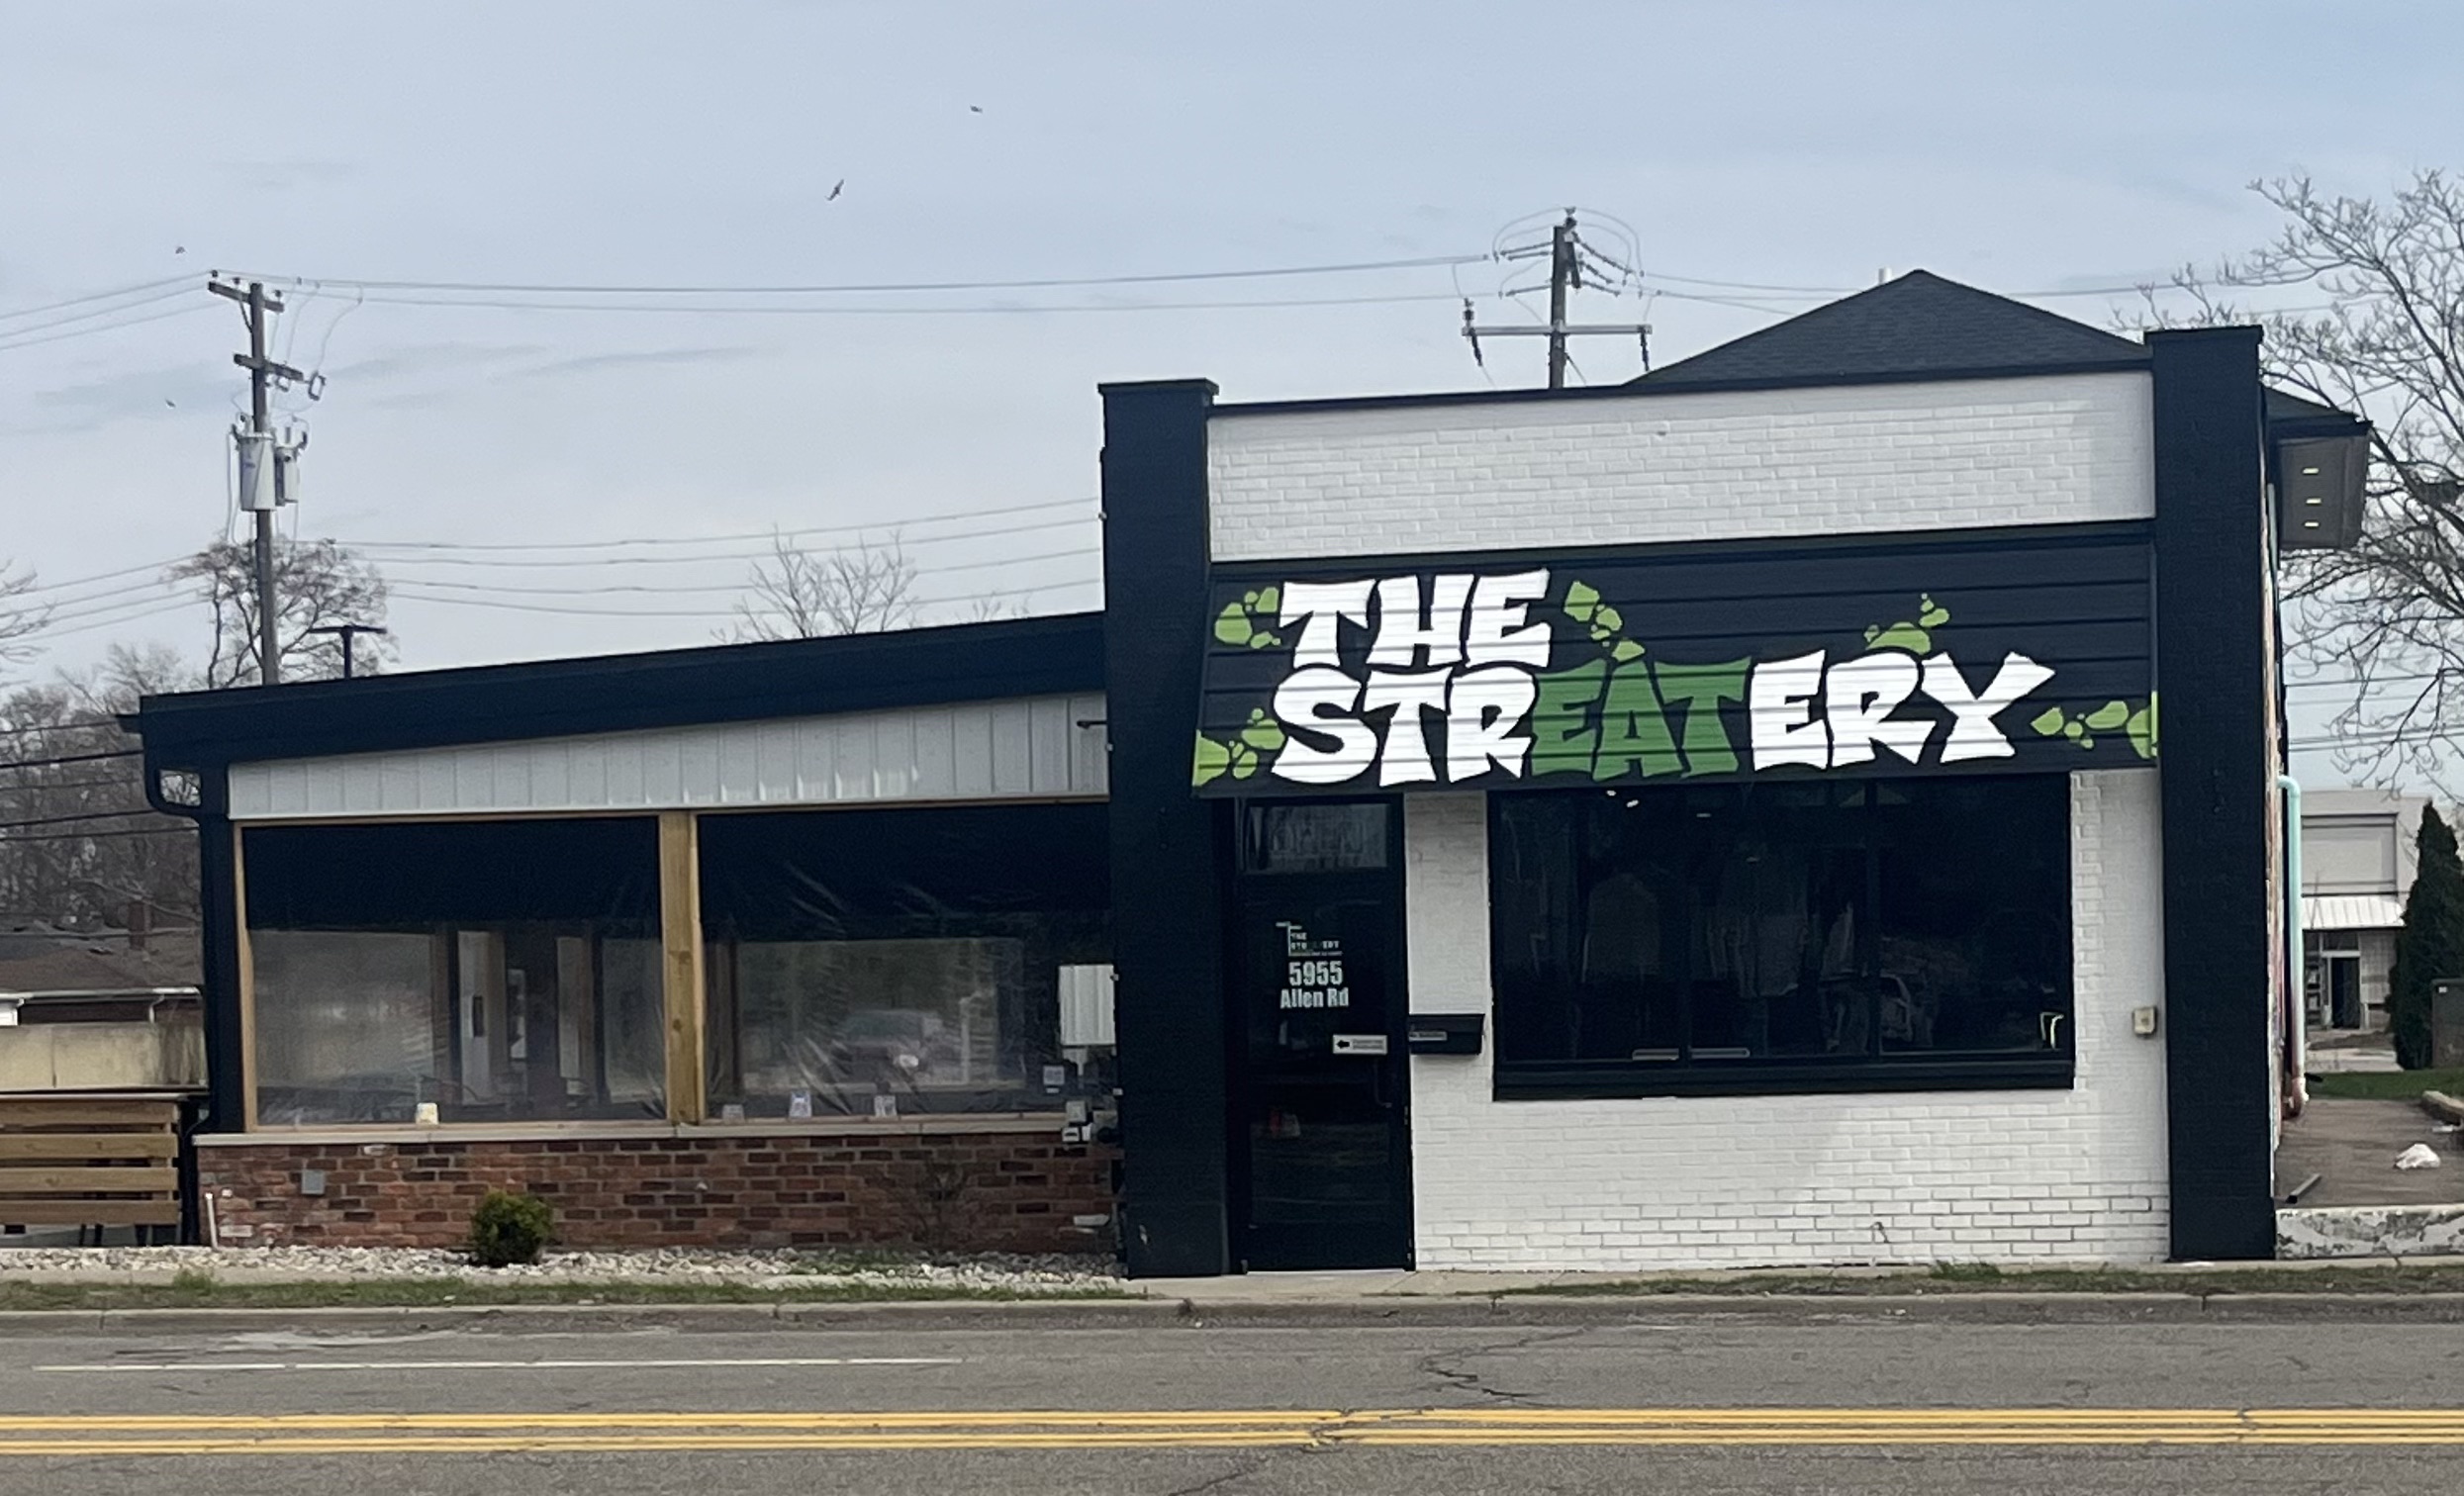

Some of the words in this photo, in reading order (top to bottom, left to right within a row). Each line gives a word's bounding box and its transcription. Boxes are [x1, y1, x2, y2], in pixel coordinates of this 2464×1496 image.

[1279, 569, 1552, 669] THE
[1271, 649, 2055, 787] STREATERY
[1279, 987, 1324, 1008] Allen
[1326, 986, 1350, 1007] Rd
[1288, 960, 1343, 986] 5955
